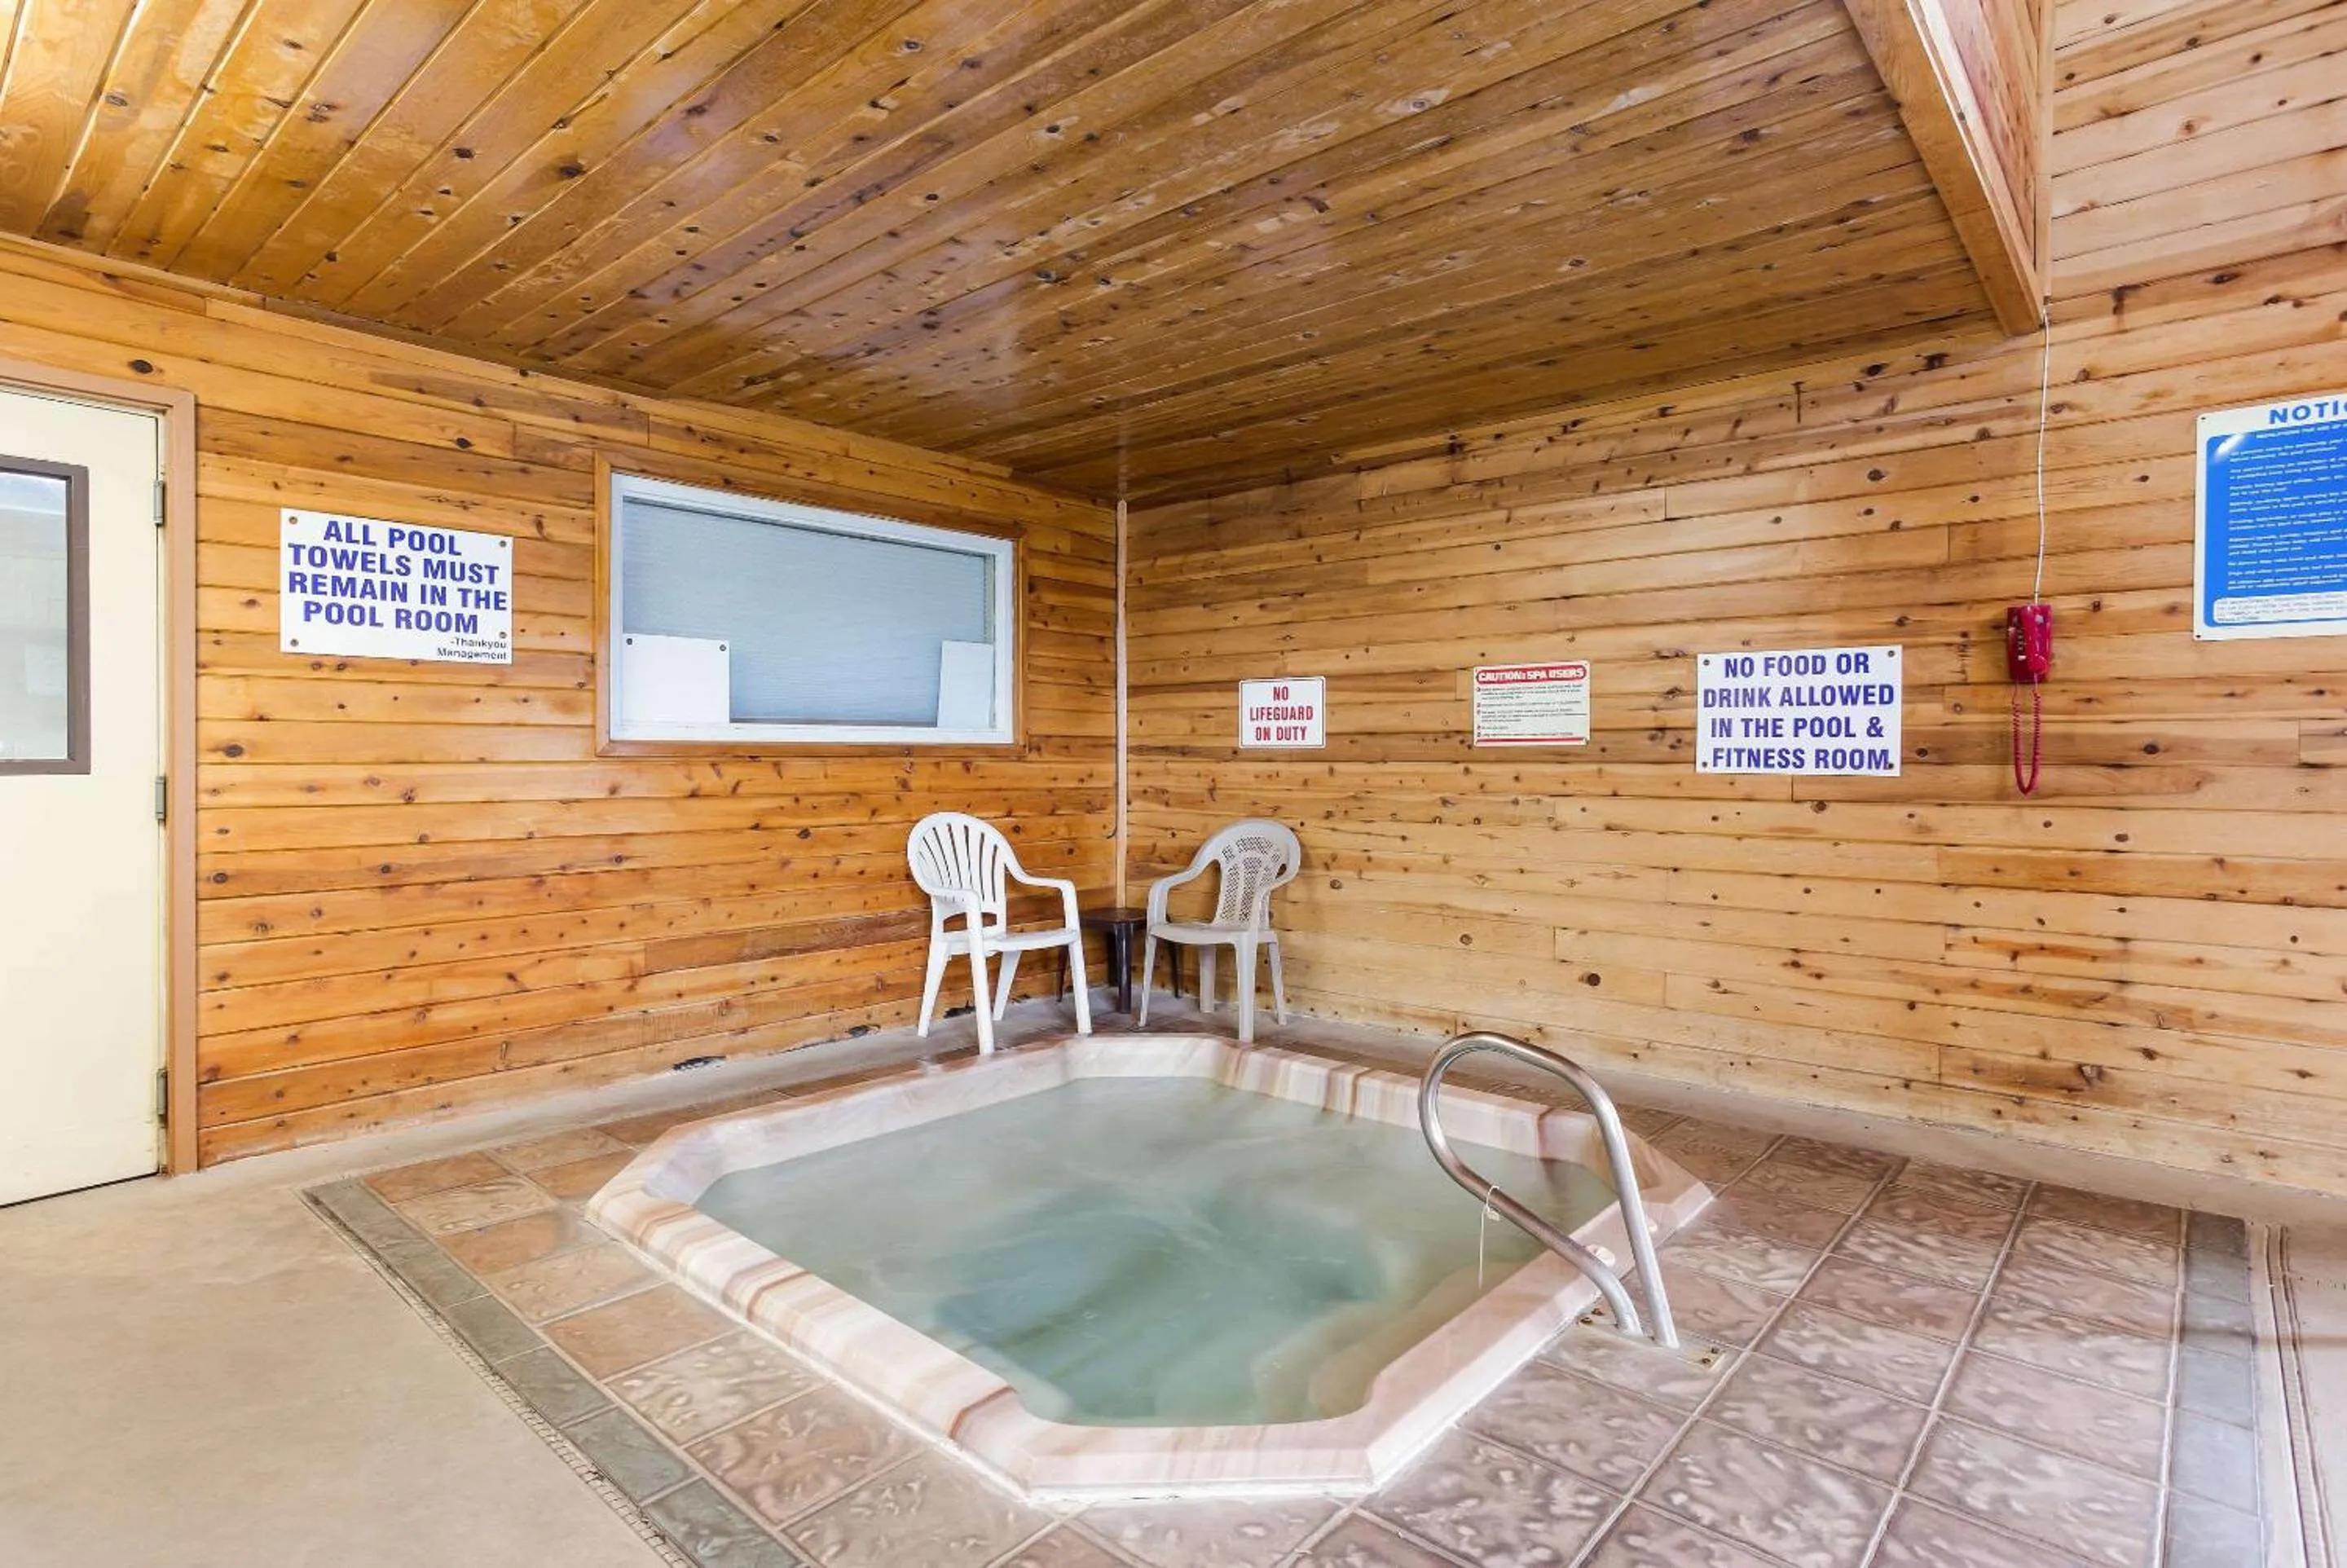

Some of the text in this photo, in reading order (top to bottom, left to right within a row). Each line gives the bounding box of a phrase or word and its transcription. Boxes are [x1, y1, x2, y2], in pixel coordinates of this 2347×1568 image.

[2269, 399, 2347, 425] NOTI
[324, 520, 461, 556] ALL POOL
[288, 543, 500, 584] TOWELS MUST
[288, 571, 508, 610] REMAIN IN THE
[302, 600, 478, 634] POOL ROOM
[438, 648, 507, 659] Management
[1527, 670, 1547, 680] SPA
[1548, 668, 1584, 679] USERS
[1724, 653, 1869, 678] NO FOOD OR
[1273, 686, 1288, 701] NO
[1703, 684, 1894, 708] DRINK ALLOWED
[1249, 706, 1314, 721] LIFEGUARD
[1256, 726, 1307, 741] ON DUTY
[1711, 716, 1884, 738] IN THE POOL &
[1712, 747, 1889, 770] FITNESS ROOM
